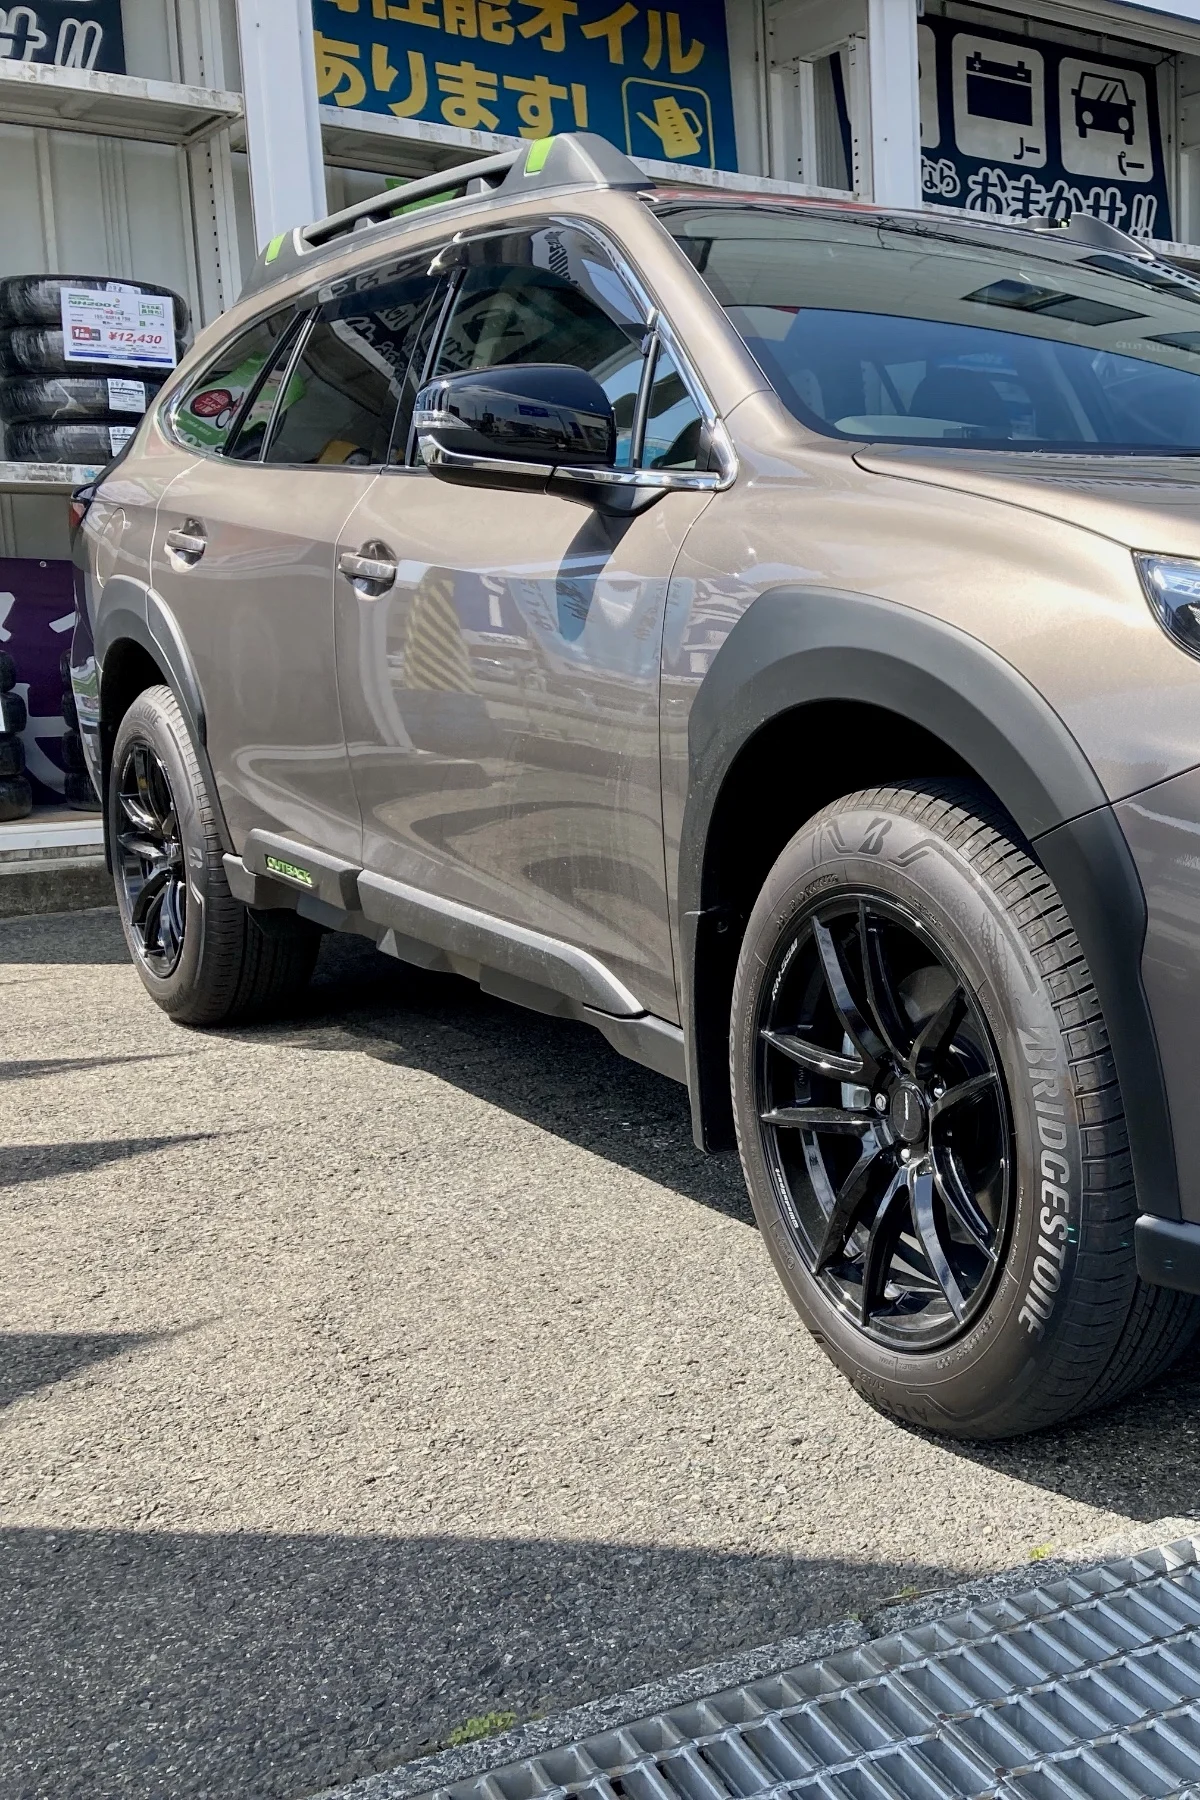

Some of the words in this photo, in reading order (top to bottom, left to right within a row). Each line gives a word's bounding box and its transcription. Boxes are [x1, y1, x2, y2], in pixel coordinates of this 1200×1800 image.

[314, 28, 589, 141] あります!
[108, 331, 162, 344] ¥12,430
[266, 856, 313, 885] OUTBACK
[1017, 1026, 1073, 1343] BRIDGESTONE
